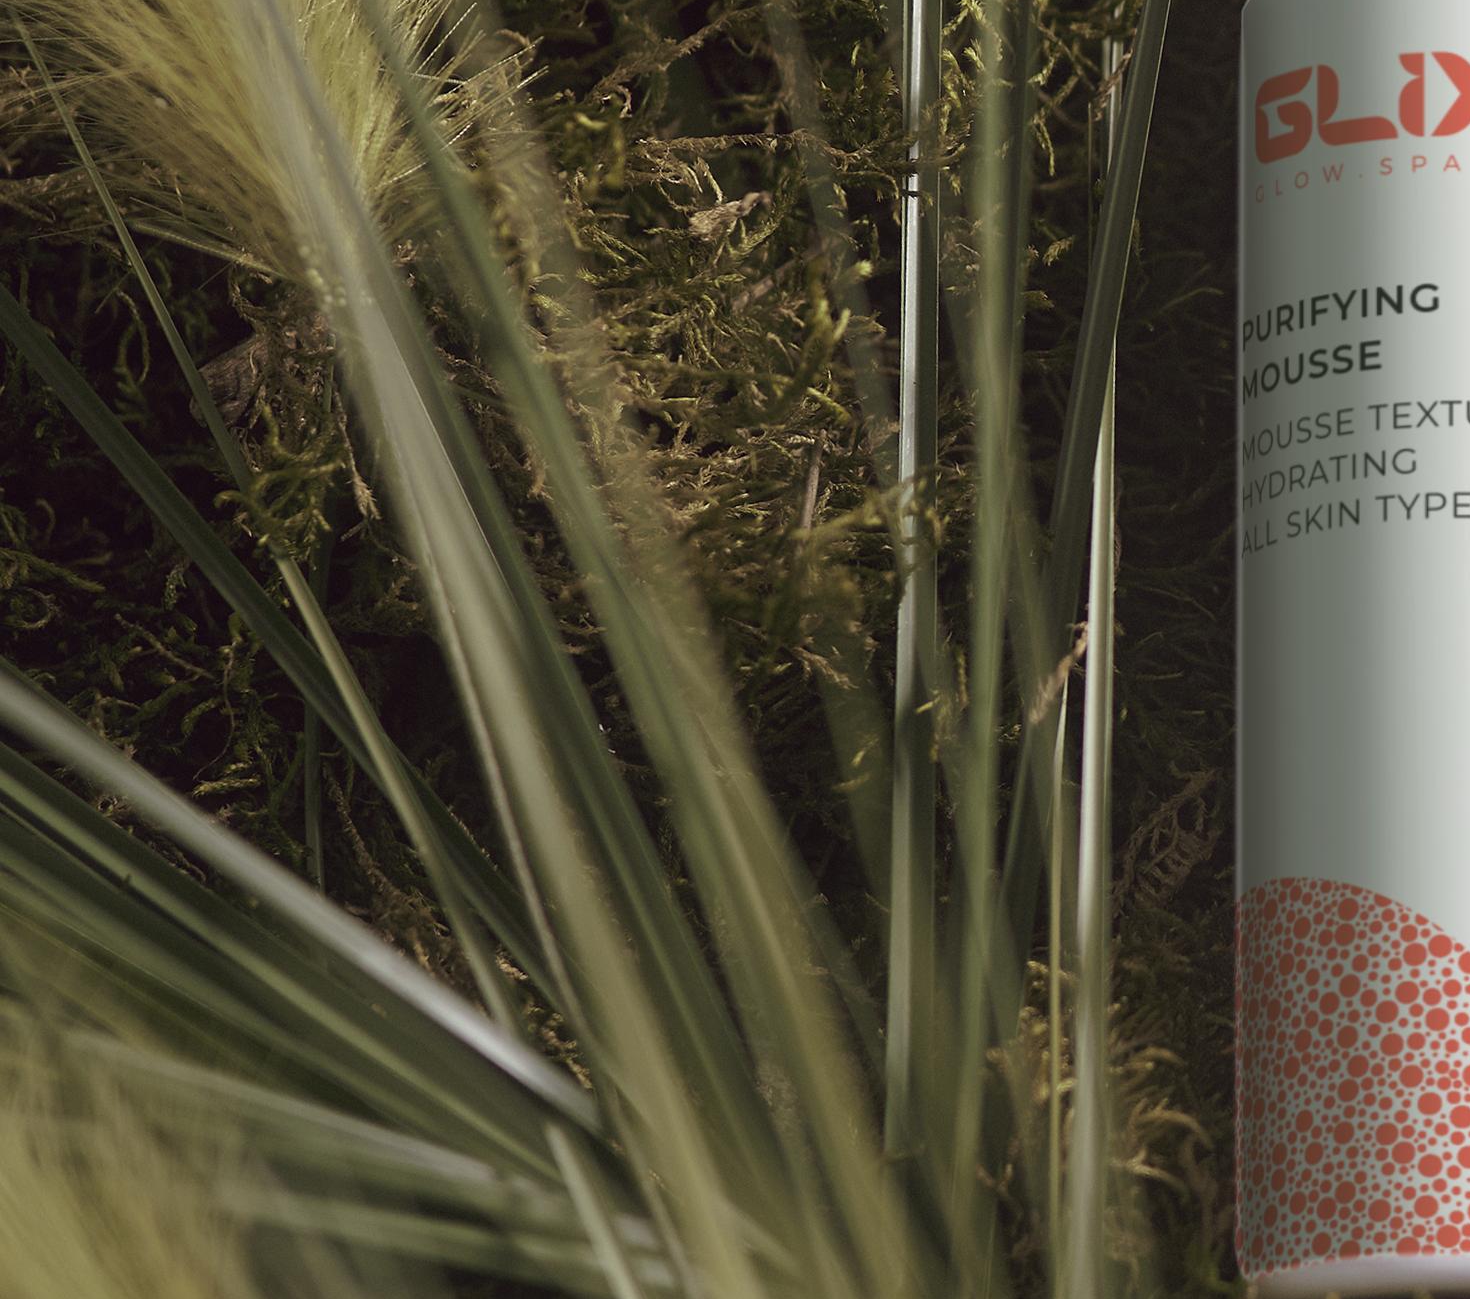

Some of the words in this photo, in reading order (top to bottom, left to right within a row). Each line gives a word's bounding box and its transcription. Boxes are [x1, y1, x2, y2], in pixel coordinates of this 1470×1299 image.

[1242, 284, 1441, 351] PURIFYING
[1242, 340, 1383, 405] MOUSSE
[1242, 408, 1356, 467] MOUSSE
[1242, 448, 1417, 512] HYDRATING
[1241, 520, 1278, 558] ALL
[1286, 499, 1360, 539] SKIN
